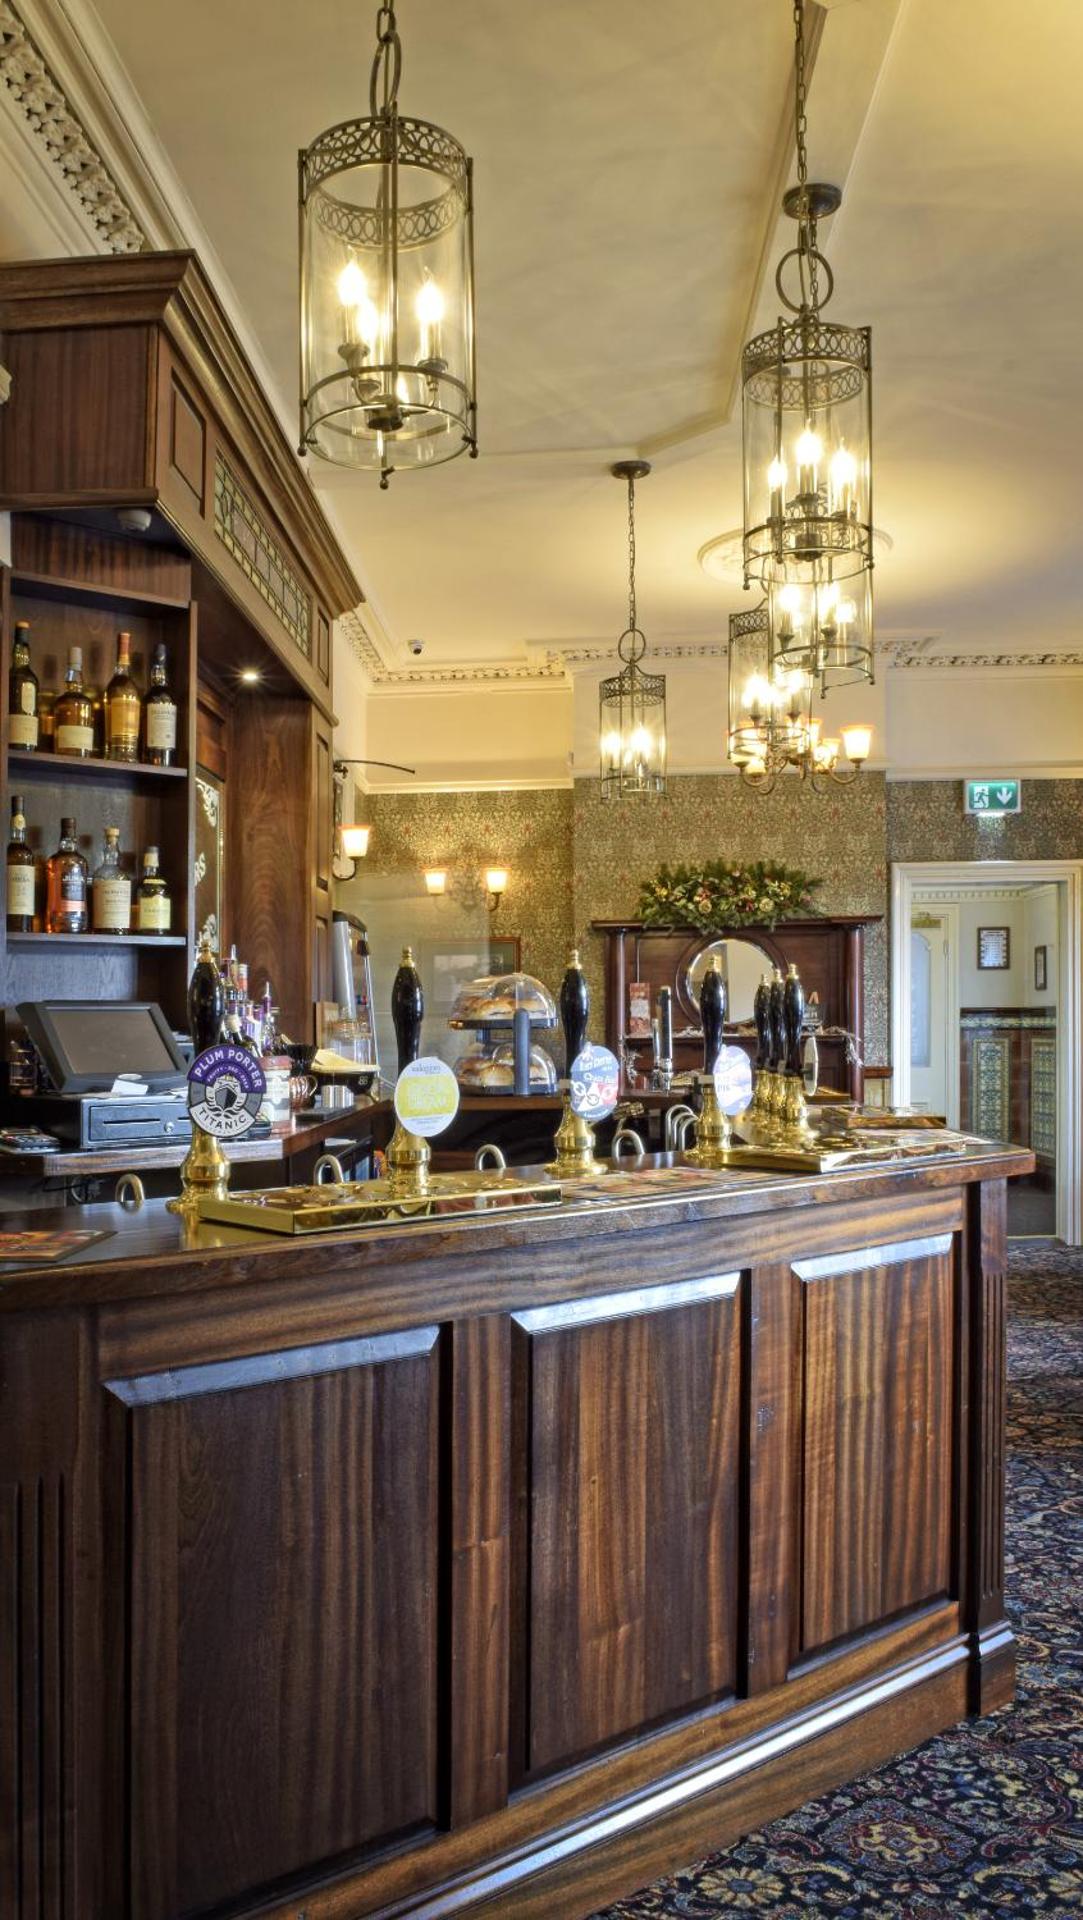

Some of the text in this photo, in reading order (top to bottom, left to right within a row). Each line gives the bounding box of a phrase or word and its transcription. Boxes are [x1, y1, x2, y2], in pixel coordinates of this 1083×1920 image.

[194, 1049, 263, 1088] PLUM PORTER
[199, 1106, 247, 1129] TITANIC
